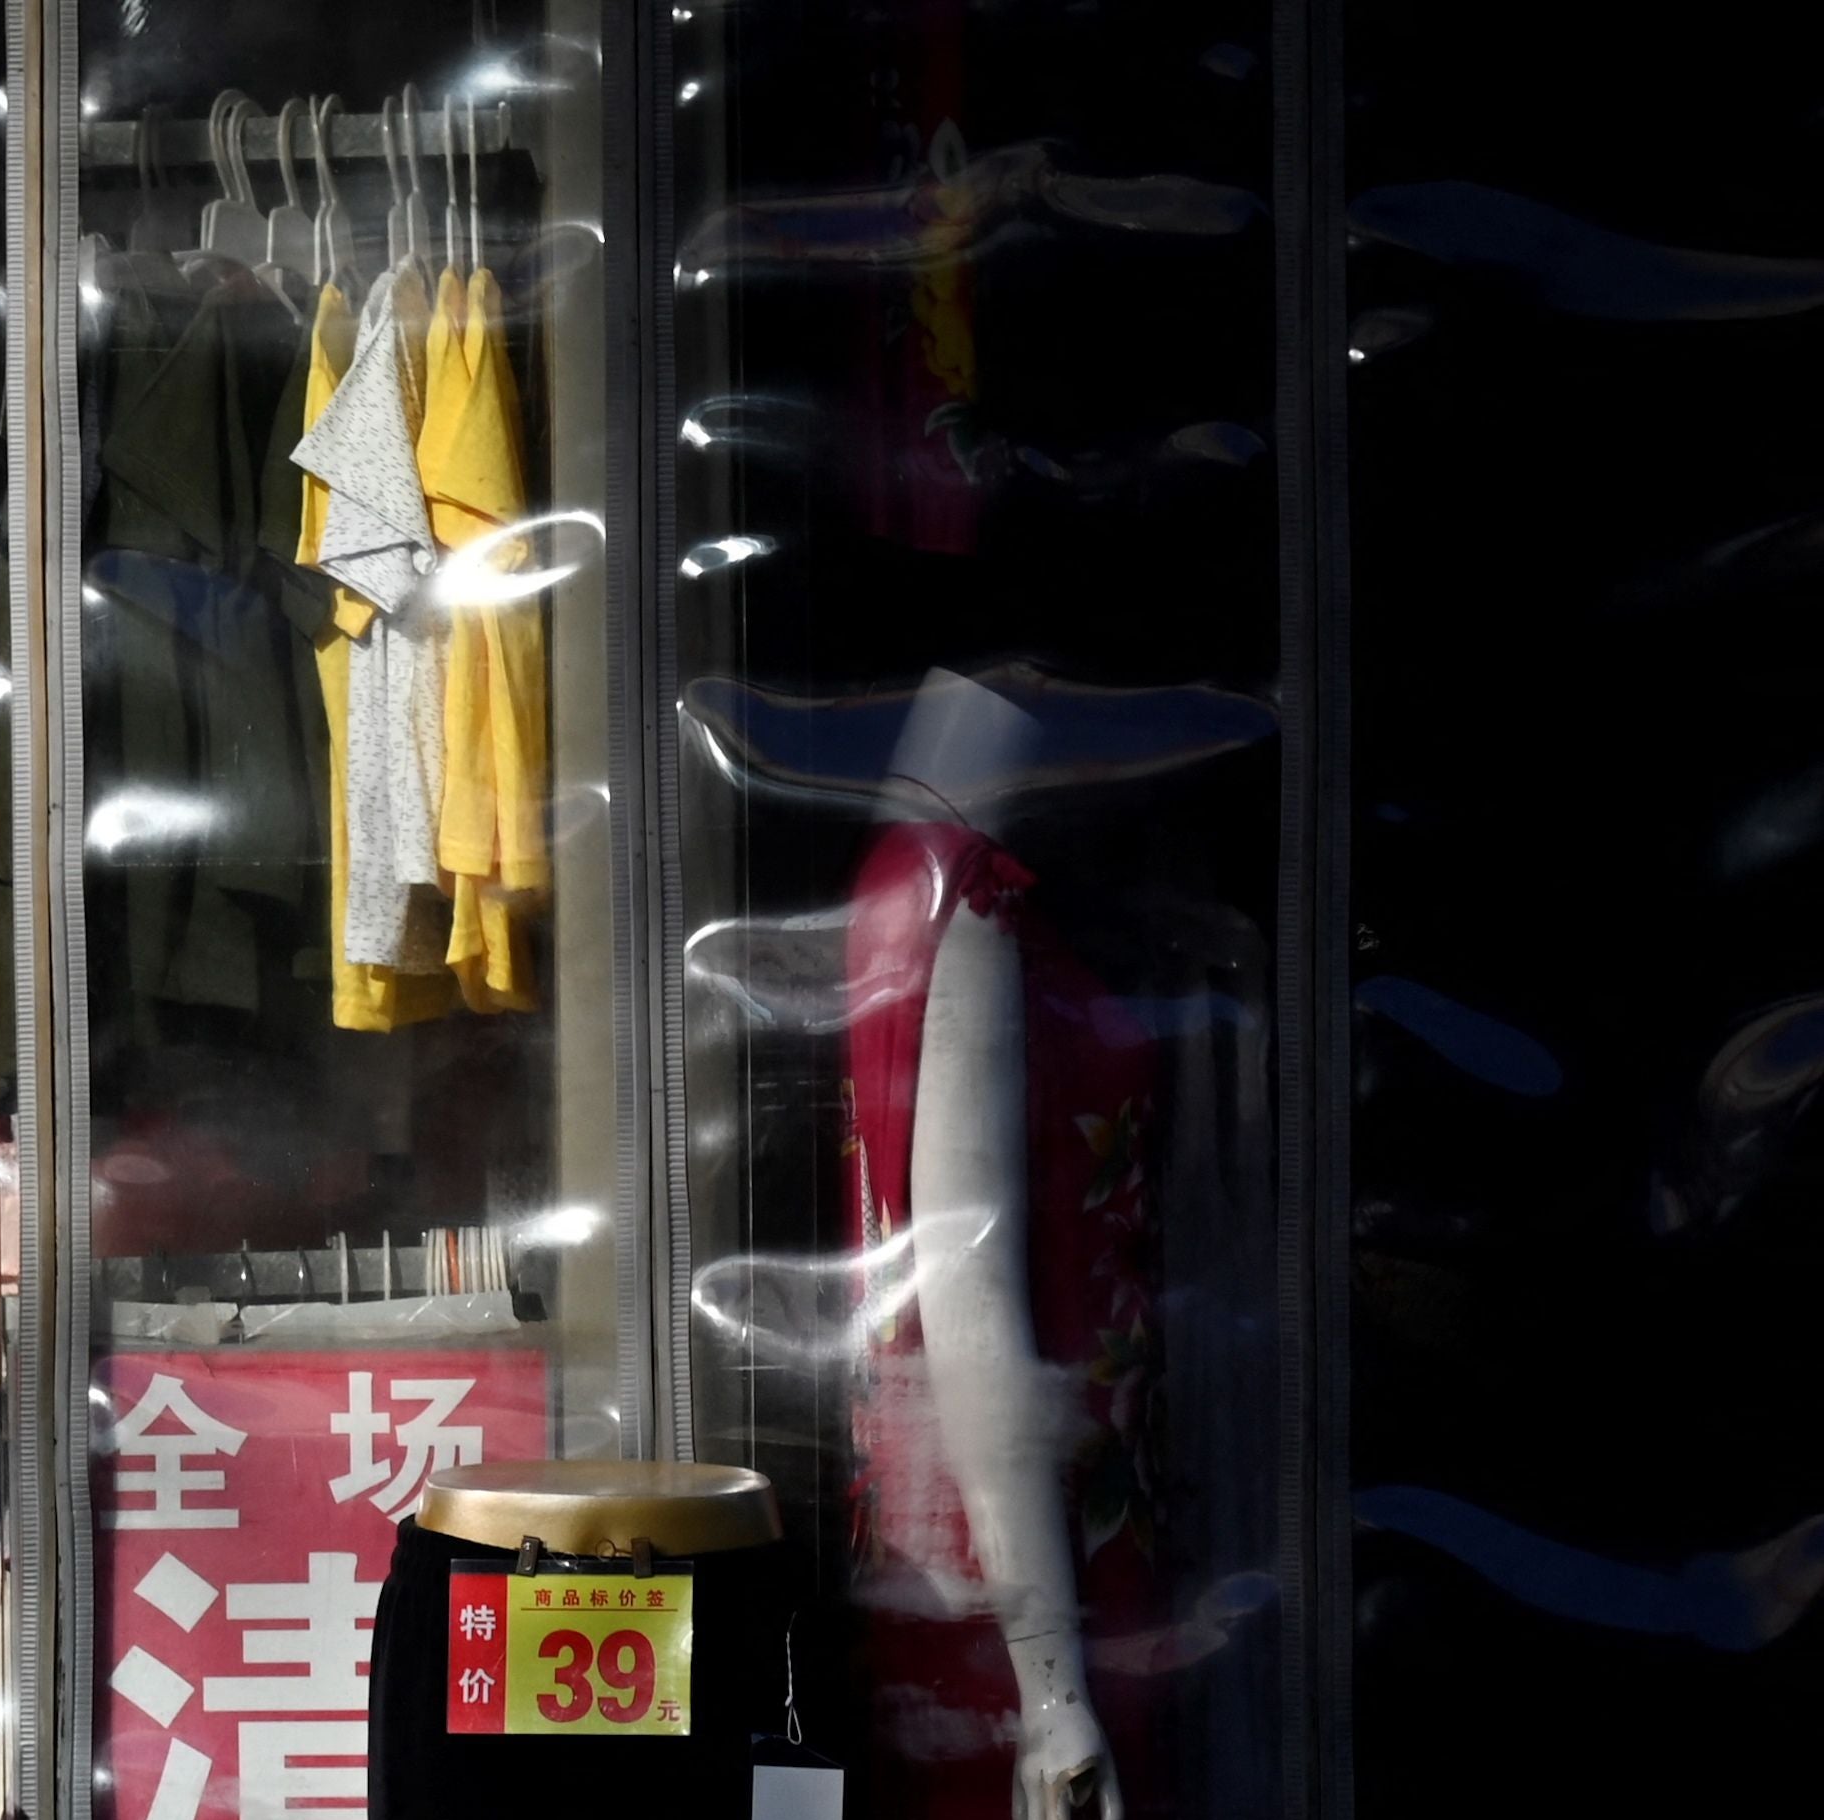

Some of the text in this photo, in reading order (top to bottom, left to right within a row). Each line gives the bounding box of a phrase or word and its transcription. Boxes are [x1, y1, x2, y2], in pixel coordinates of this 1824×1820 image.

[102, 1371, 483, 1530] 全场
[533, 1589, 665, 1608] 商品标价签
[459, 1604, 496, 1704] 特价
